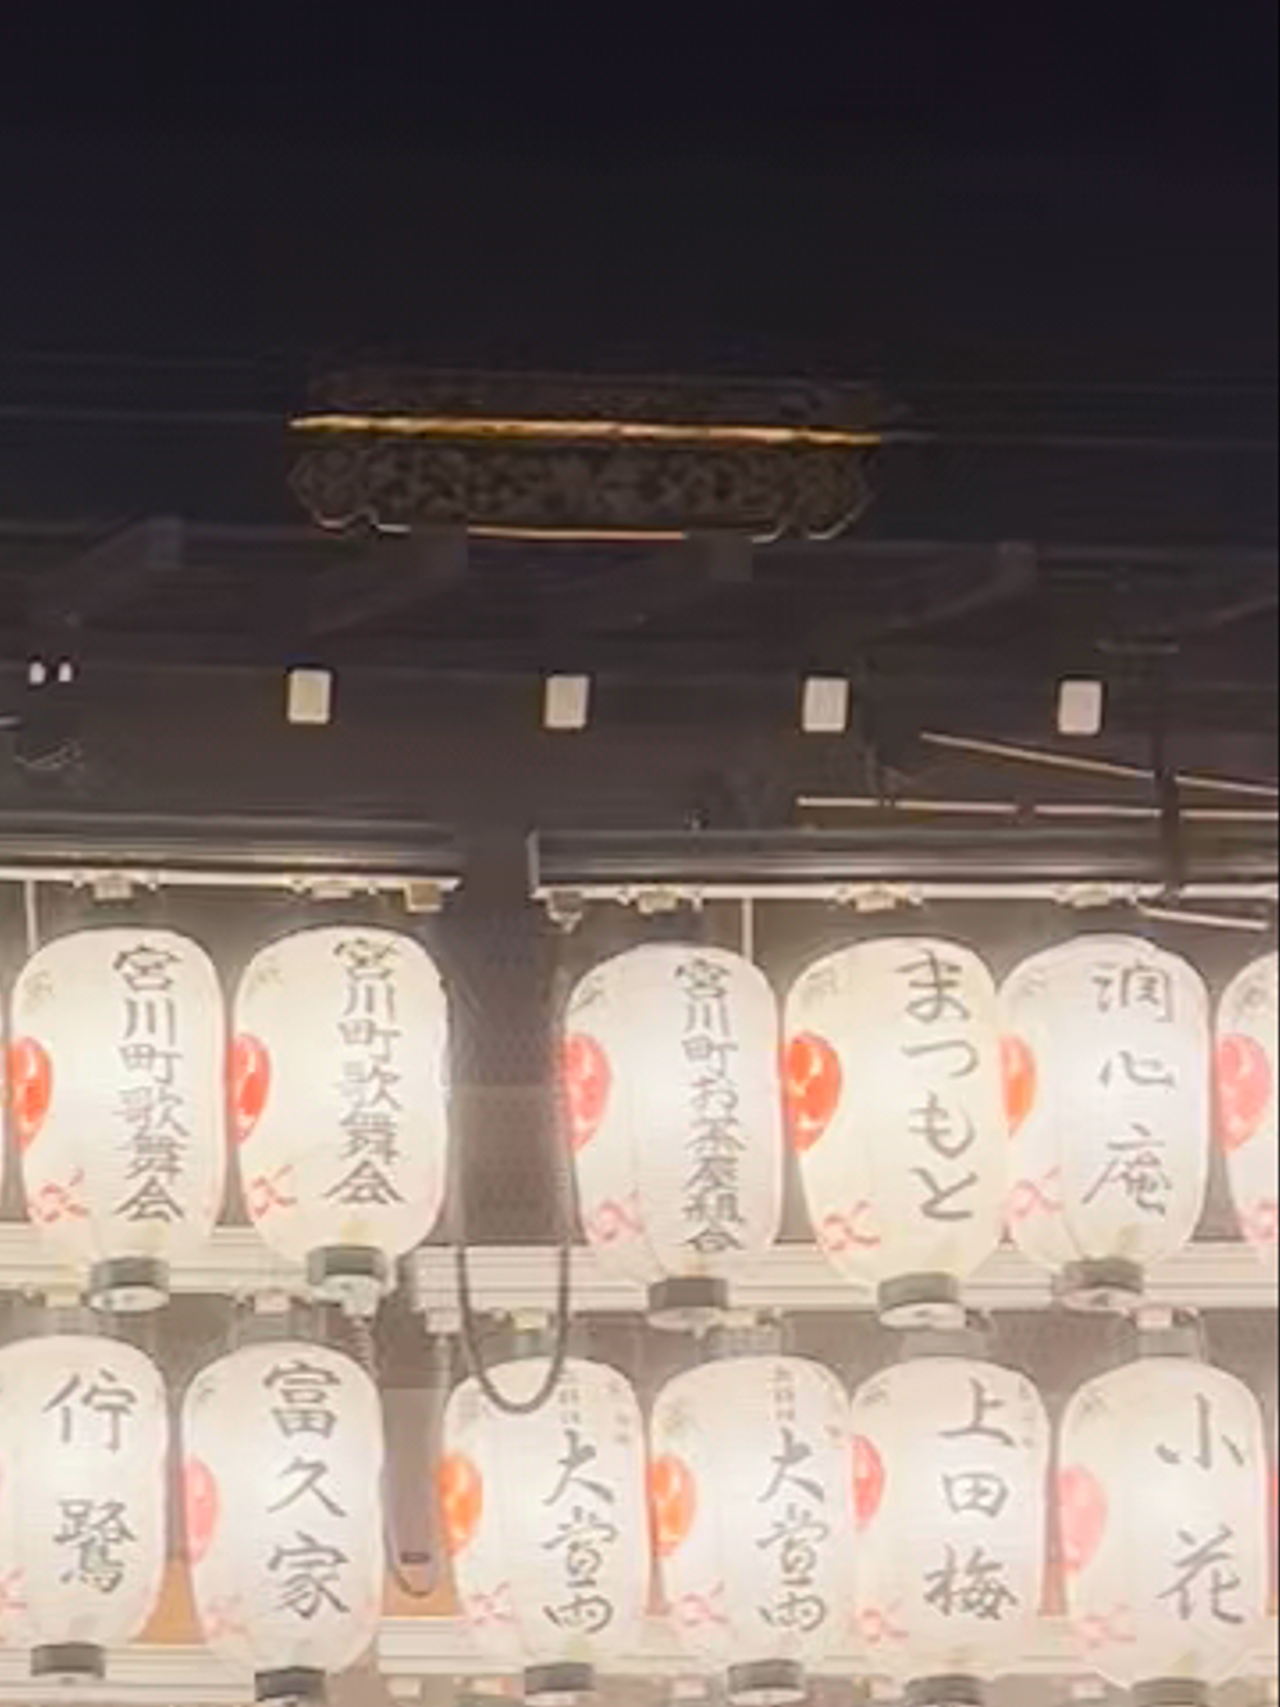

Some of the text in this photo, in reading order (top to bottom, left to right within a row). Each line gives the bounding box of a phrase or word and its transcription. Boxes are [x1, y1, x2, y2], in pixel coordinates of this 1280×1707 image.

[111, 943, 191, 1223] 宮川町歌舞会
[321, 936, 404, 1207] 宮川町歌舞会
[673, 958, 746, 1252] 宮川町お茶屋組合
[894, 948, 980, 1223] まつもと
[263, 1359, 352, 1619] 富久家
[924, 1378, 1020, 1623] 上田梅
[1154, 1393, 1248, 1625] 小花
